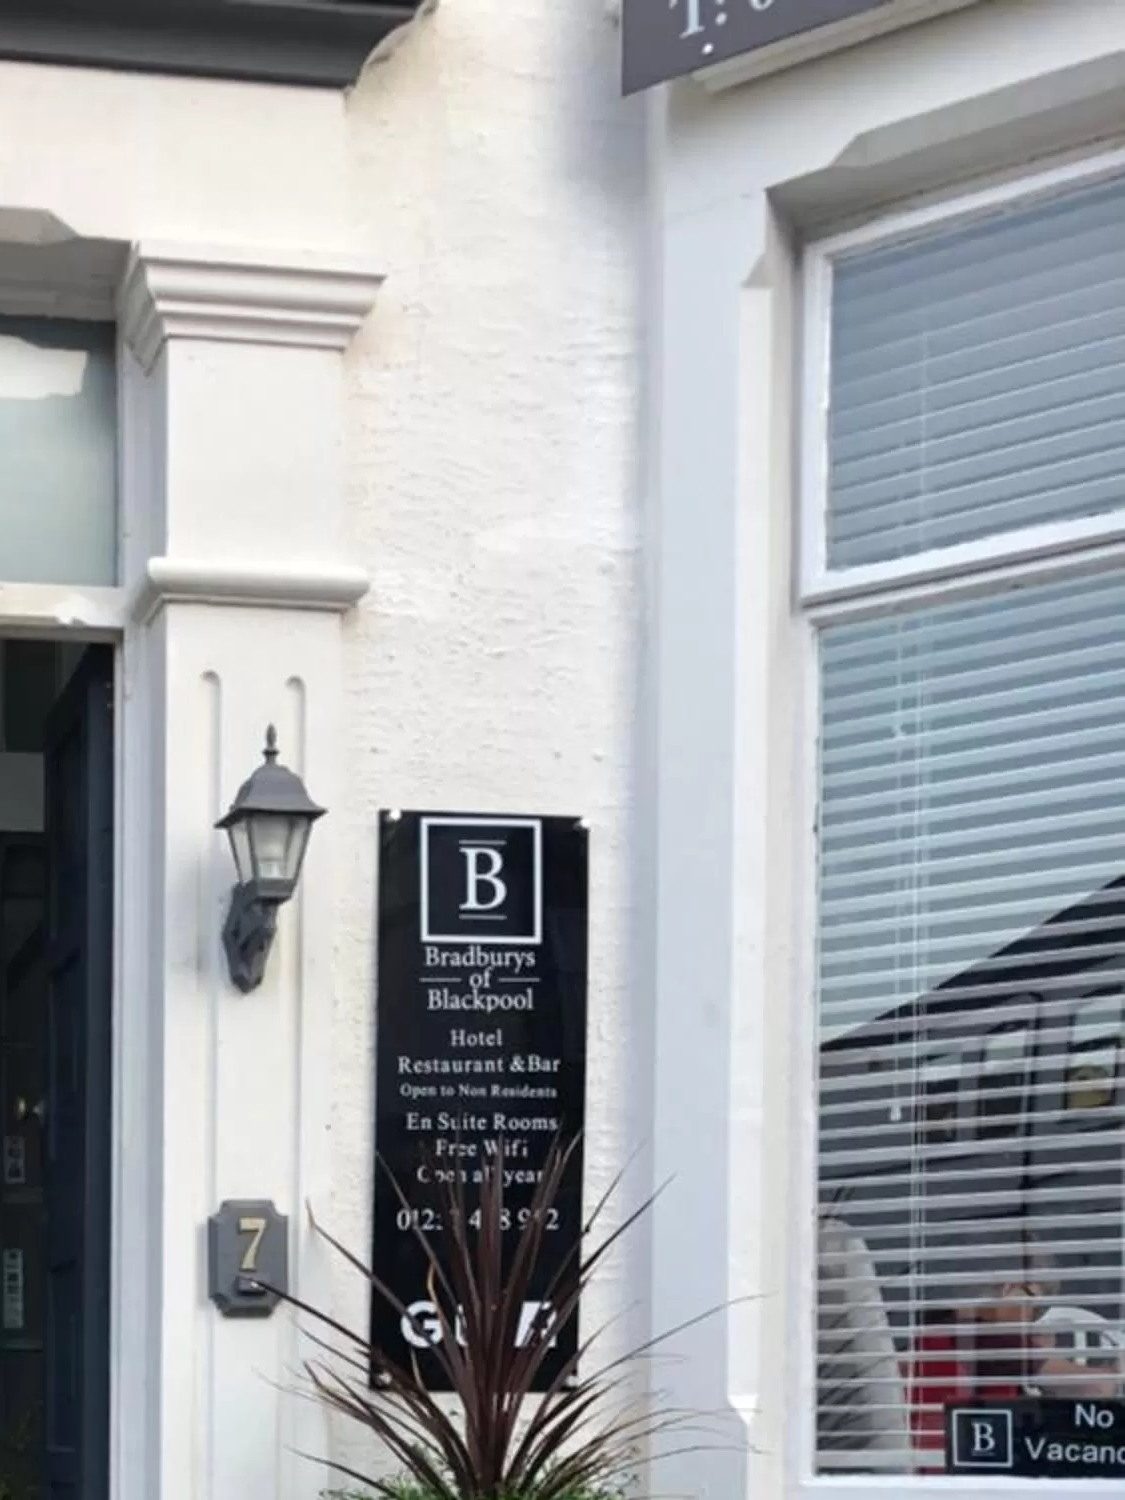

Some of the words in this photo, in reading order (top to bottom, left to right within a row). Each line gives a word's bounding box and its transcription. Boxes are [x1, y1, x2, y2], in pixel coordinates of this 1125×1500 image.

[459, 846, 508, 911] B
[424, 946, 536, 974] Bradburys
[469, 966, 492, 989] of
[427, 987, 535, 1012] Blackpool
[450, 1029, 503, 1047] Hotel
[397, 1055, 505, 1075] Restaurant
[399, 1082, 437, 1099] Open
[440, 1084, 456, 1097] to
[458, 1083, 487, 1098] Non
[490, 1083, 558, 1099] Residents
[406, 1111, 432, 1131] En
[437, 1111, 488, 1131] Suite
[493, 1112, 559, 1131] Rooms
[238, 1217, 267, 1272] 7
[1075, 1404, 1115, 1428] No
[971, 1421, 996, 1451] B
